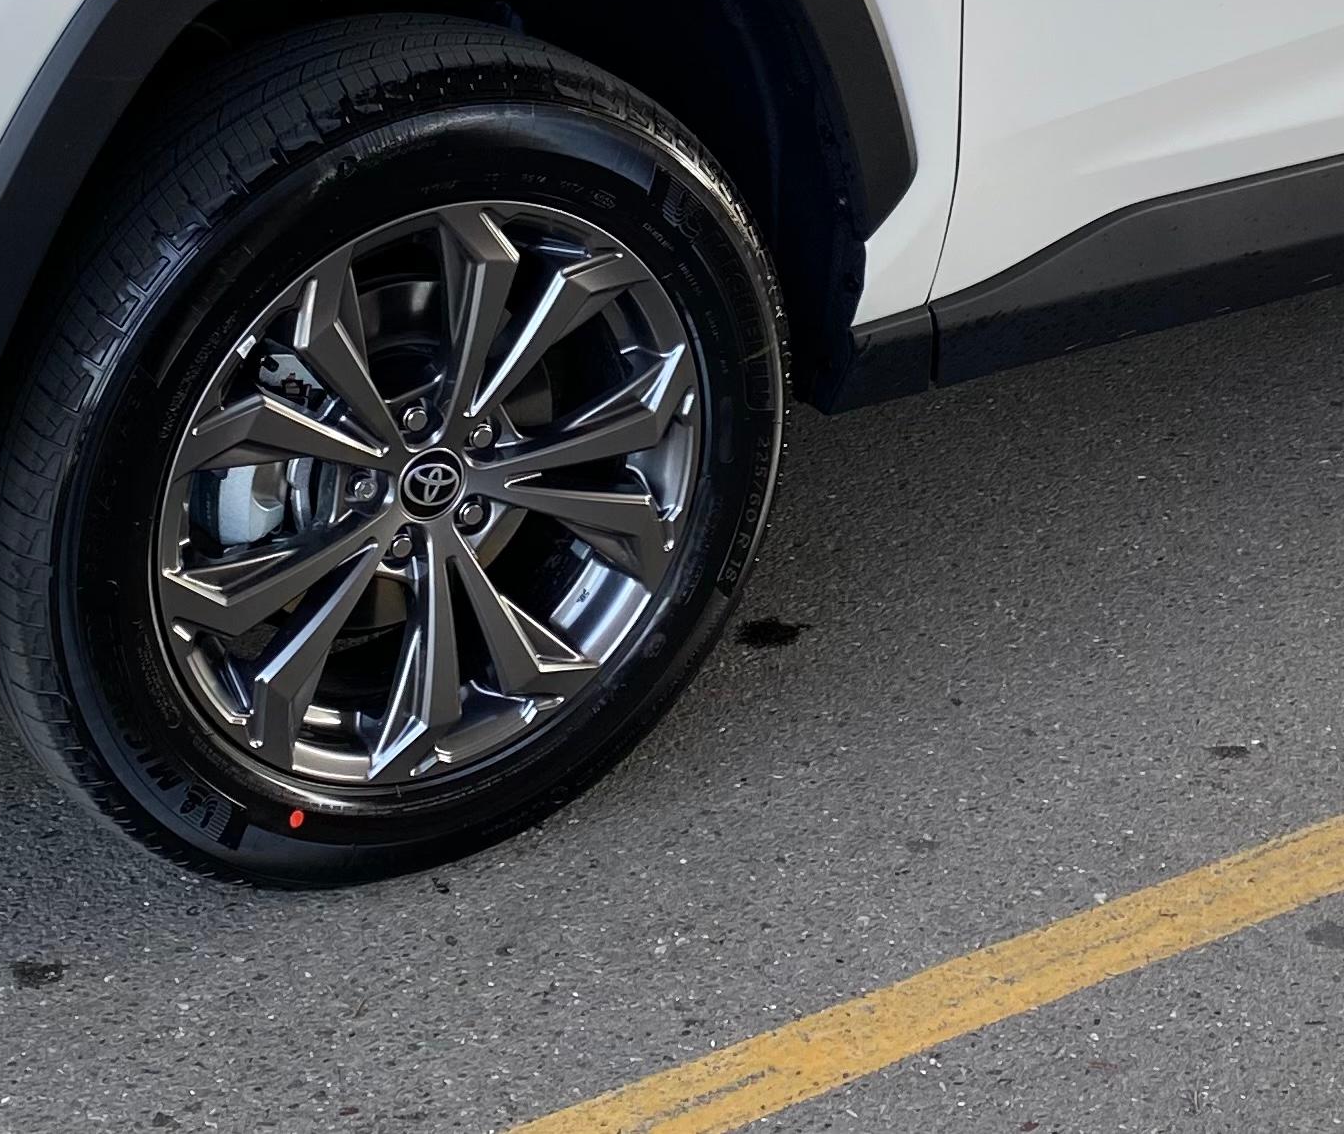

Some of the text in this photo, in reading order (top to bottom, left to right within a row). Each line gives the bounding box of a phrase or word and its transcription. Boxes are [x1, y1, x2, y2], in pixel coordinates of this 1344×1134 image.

[725, 435, 770, 583] 225/60 R 18
